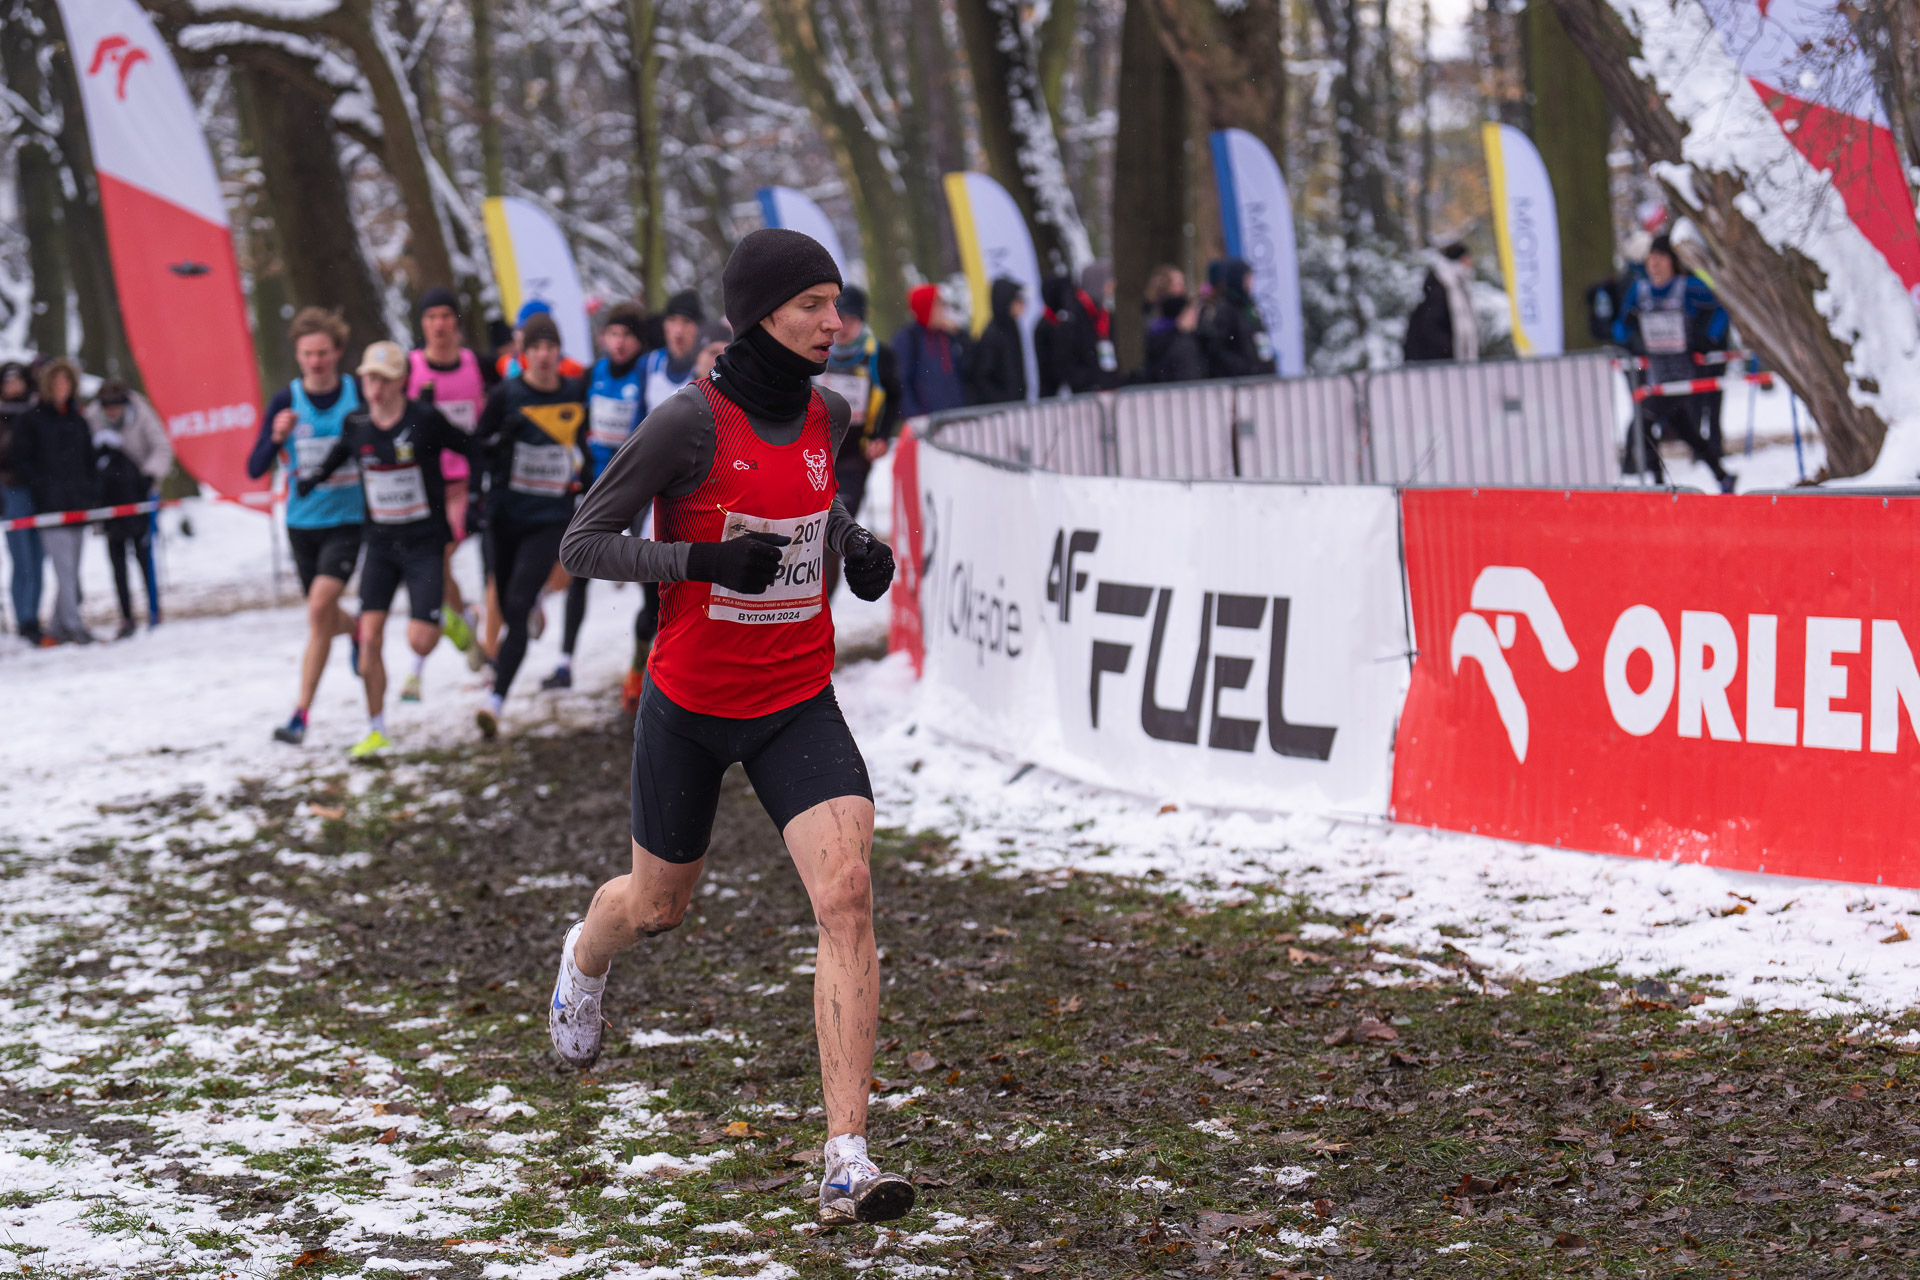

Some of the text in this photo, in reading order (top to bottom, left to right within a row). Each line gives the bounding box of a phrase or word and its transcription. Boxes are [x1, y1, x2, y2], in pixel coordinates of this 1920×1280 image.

[792, 519, 821, 545] 207
[770, 557, 820, 587] PICKI
[1047, 528, 1100, 622] 4F
[738, 611, 800, 622] BYTOM 2024
[1090, 581, 1338, 761] FUEL
